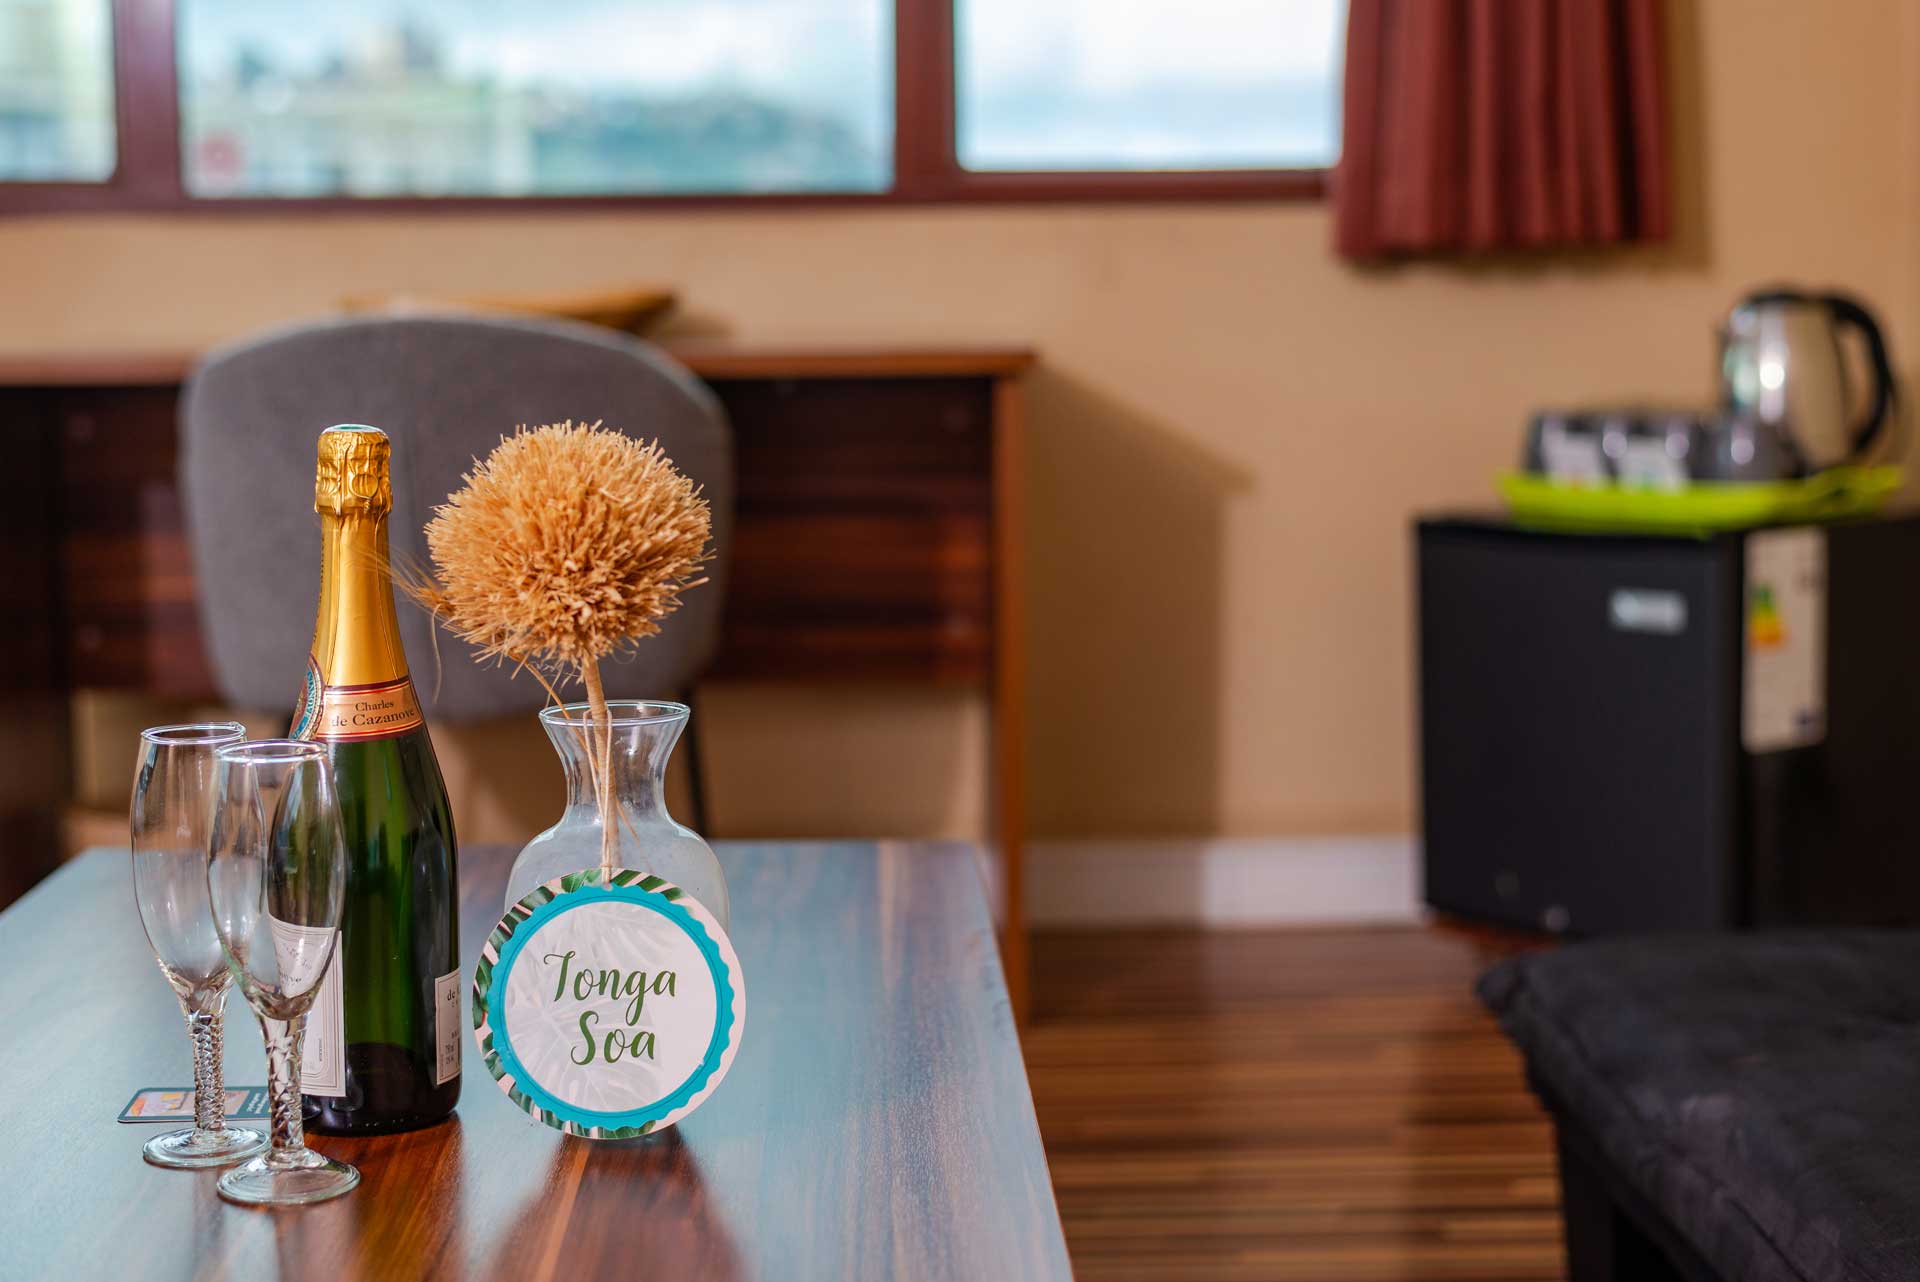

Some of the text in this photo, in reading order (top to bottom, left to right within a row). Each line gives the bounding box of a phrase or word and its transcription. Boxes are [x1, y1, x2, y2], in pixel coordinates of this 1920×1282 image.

[332, 709, 415, 727] de Cazanove
[355, 700, 395, 712] Charles
[543, 950, 677, 1026] Tonga
[570, 1010, 656, 1066] Soa
